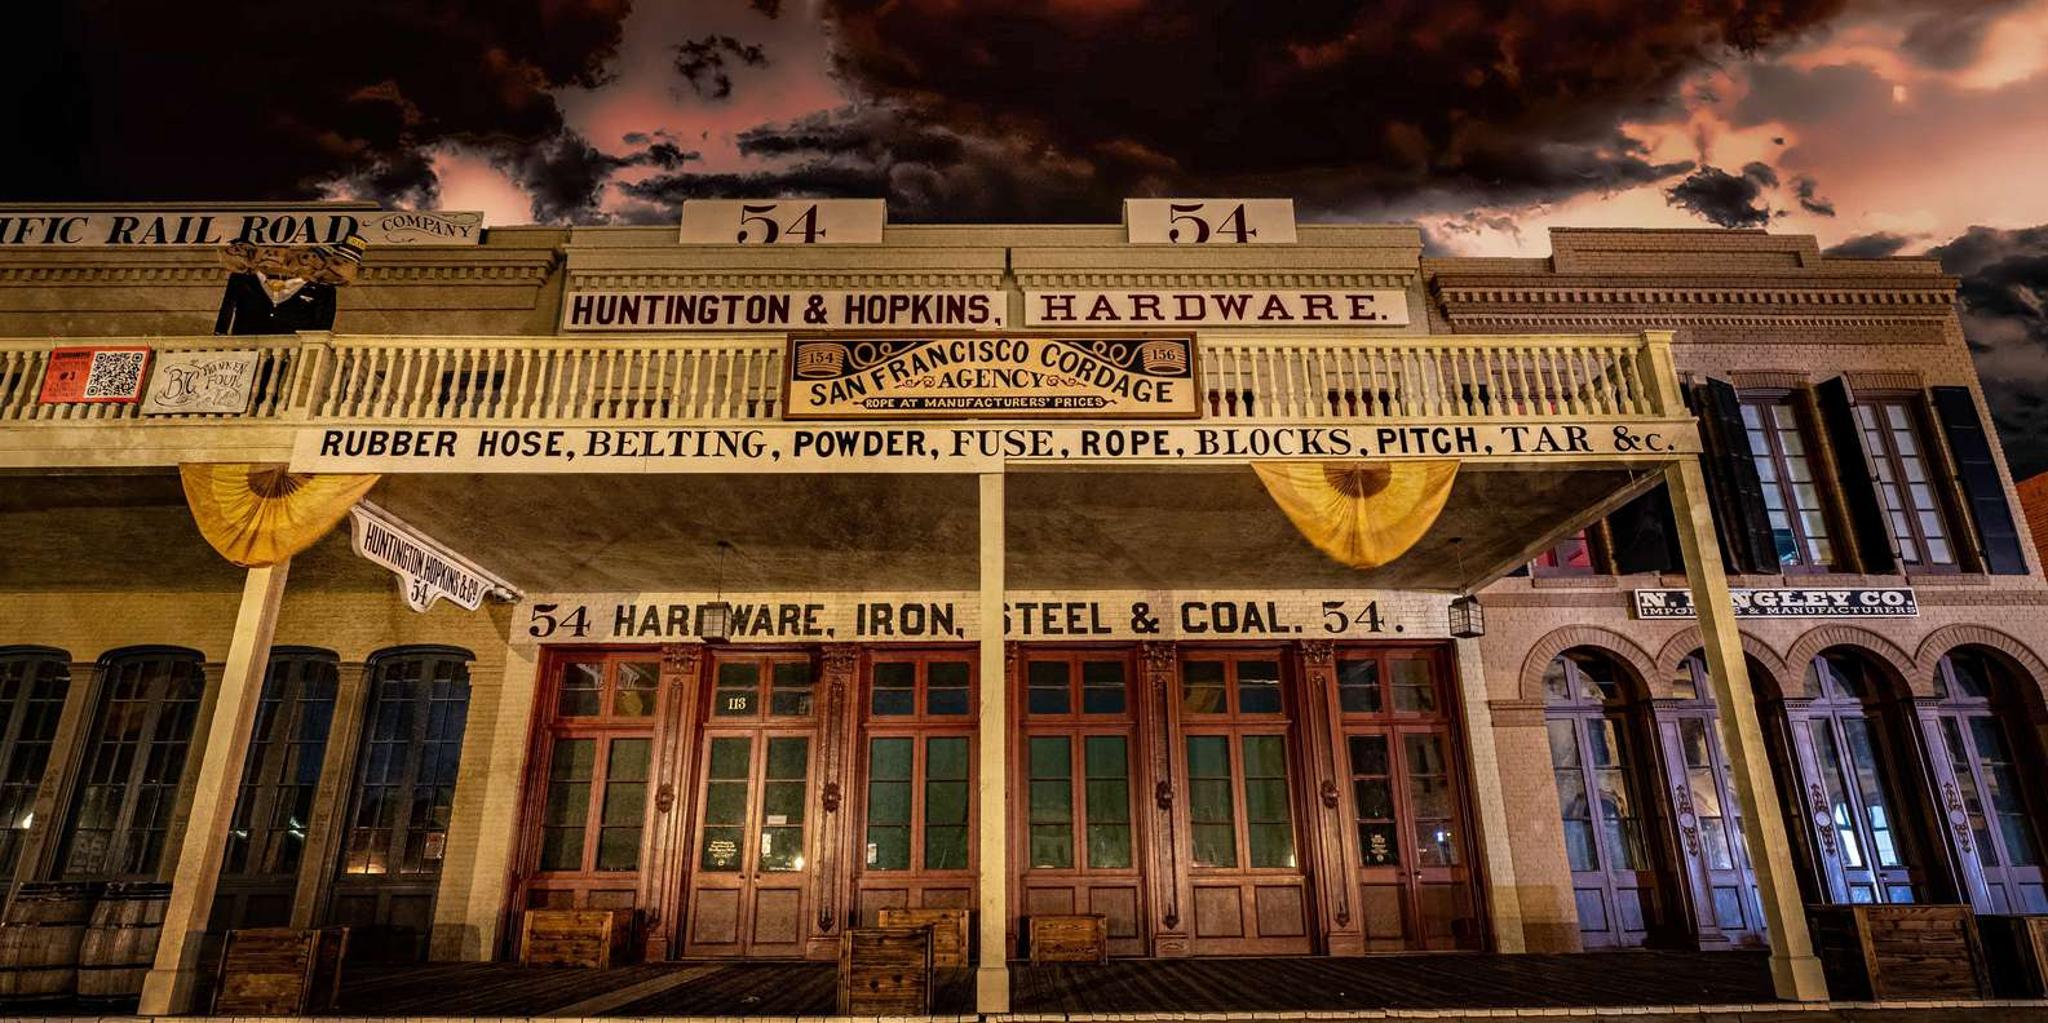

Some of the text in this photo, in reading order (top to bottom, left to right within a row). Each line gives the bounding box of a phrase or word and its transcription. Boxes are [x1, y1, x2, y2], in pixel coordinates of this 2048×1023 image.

[105, 216, 222, 244] RAIL
[237, 215, 359, 245] ROAD
[382, 215, 473, 238] COMPANY
[737, 204, 826, 243] 54
[1169, 203, 1257, 243] 54
[571, 294, 1001, 326] HUNTINGTON & HOPKINS,
[1040, 294, 1387, 321] HARDWARE.
[809, 352, 834, 364] 154
[1151, 348, 1176, 361] 156
[809, 339, 1174, 406] SAN FRANCISCO CORDAGE
[937, 368, 1045, 389] AGENCY
[866, 396, 1104, 409] ROPE AT MANUFACTURERS' PRICES
[320, 430, 458, 457] RUBBER
[477, 430, 576, 462] HOSE,
[583, 430, 780, 462] BELTING,
[793, 431, 939, 460] POWDER,
[949, 430, 1070, 459] FUSE,
[1081, 430, 1184, 458] ROPE,
[1194, 428, 1368, 457] BLOCKS,
[1376, 427, 1493, 455] PITCH,
[1501, 425, 1594, 453] TAR
[423, 555, 461, 597] HOPKINS
[411, 577, 429, 606] 54
[1640, 592, 1677, 608] N.
[1860, 590, 1914, 606] CO.
[529, 603, 591, 638] 54
[856, 602, 964, 640] IRON,
[1004, 602, 1112, 635] TEEL
[1131, 602, 1160, 634] &
[1181, 601, 1303, 634] COAL.
[1322, 600, 1404, 634] 54.
[1748, 606, 1760, 615] &
[1767, 606, 1917, 615] MANUFACTURERS
